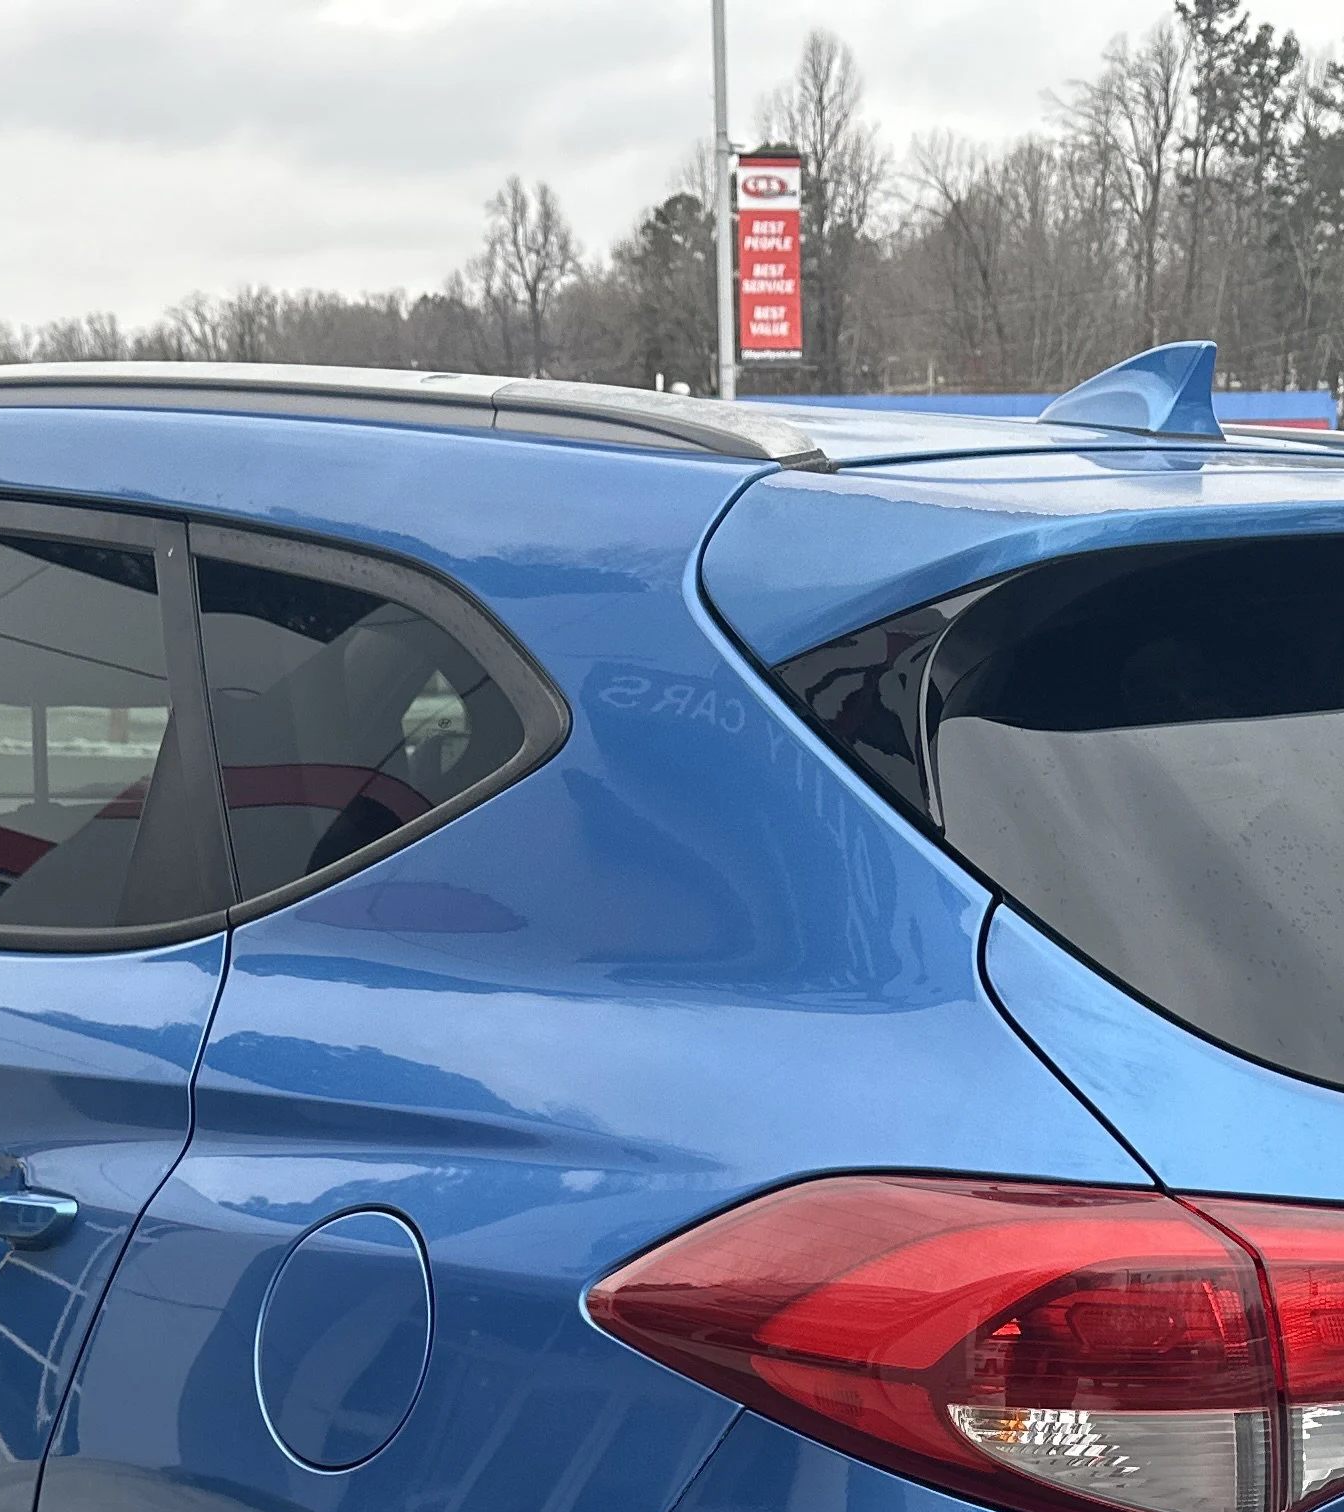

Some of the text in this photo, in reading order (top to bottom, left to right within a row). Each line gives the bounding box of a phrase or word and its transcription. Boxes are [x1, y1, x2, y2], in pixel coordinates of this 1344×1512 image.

[752, 220, 786, 234] BEST
[744, 236, 793, 251] PEOPLE
[752, 263, 786, 277] BEST
[742, 279, 795, 294] SERVICE
[753, 306, 786, 319] BEST
[749, 321, 790, 336] VALUE
